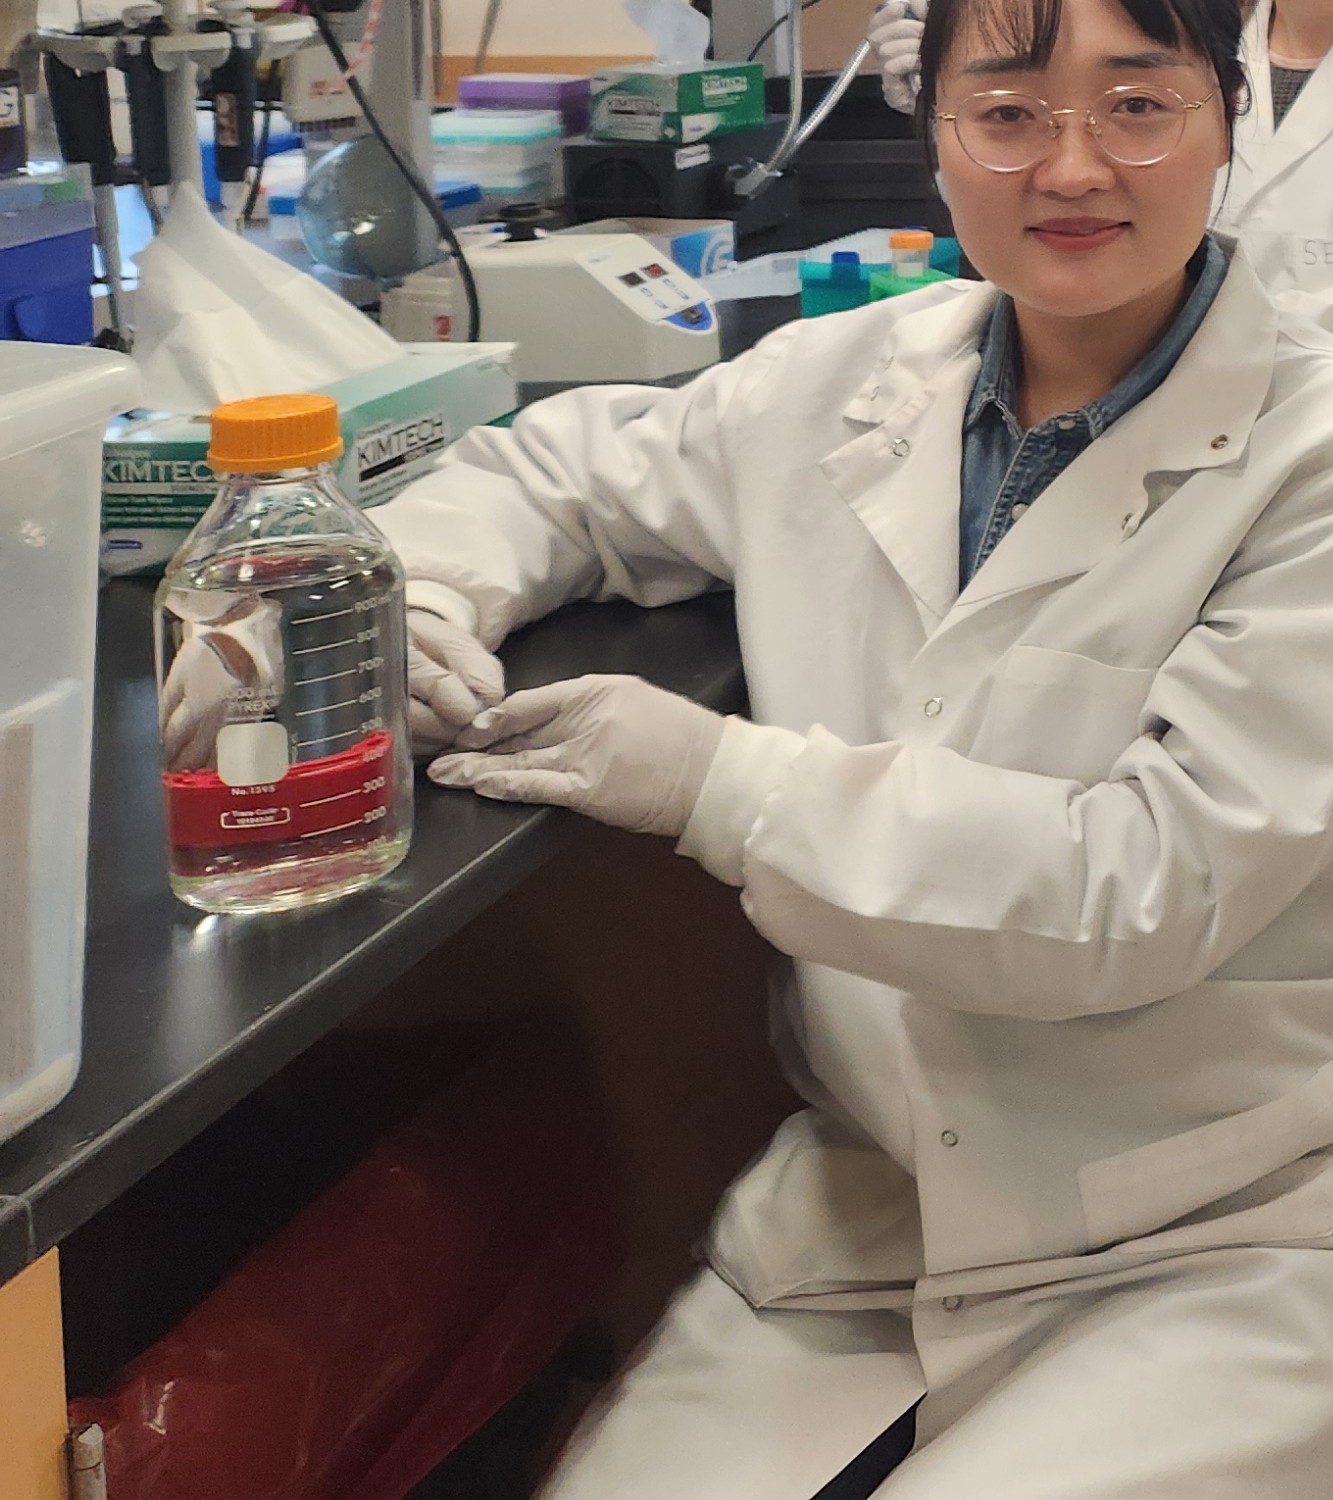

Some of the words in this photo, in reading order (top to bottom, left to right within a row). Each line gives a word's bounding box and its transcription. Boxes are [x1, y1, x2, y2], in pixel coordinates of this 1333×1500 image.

[358, 414, 443, 468] KIMTECH
[103, 460, 214, 482] KIMTEC
[227, 700, 271, 713] PYREX
[362, 775, 386, 794] 300
[364, 806, 388, 824] 200
